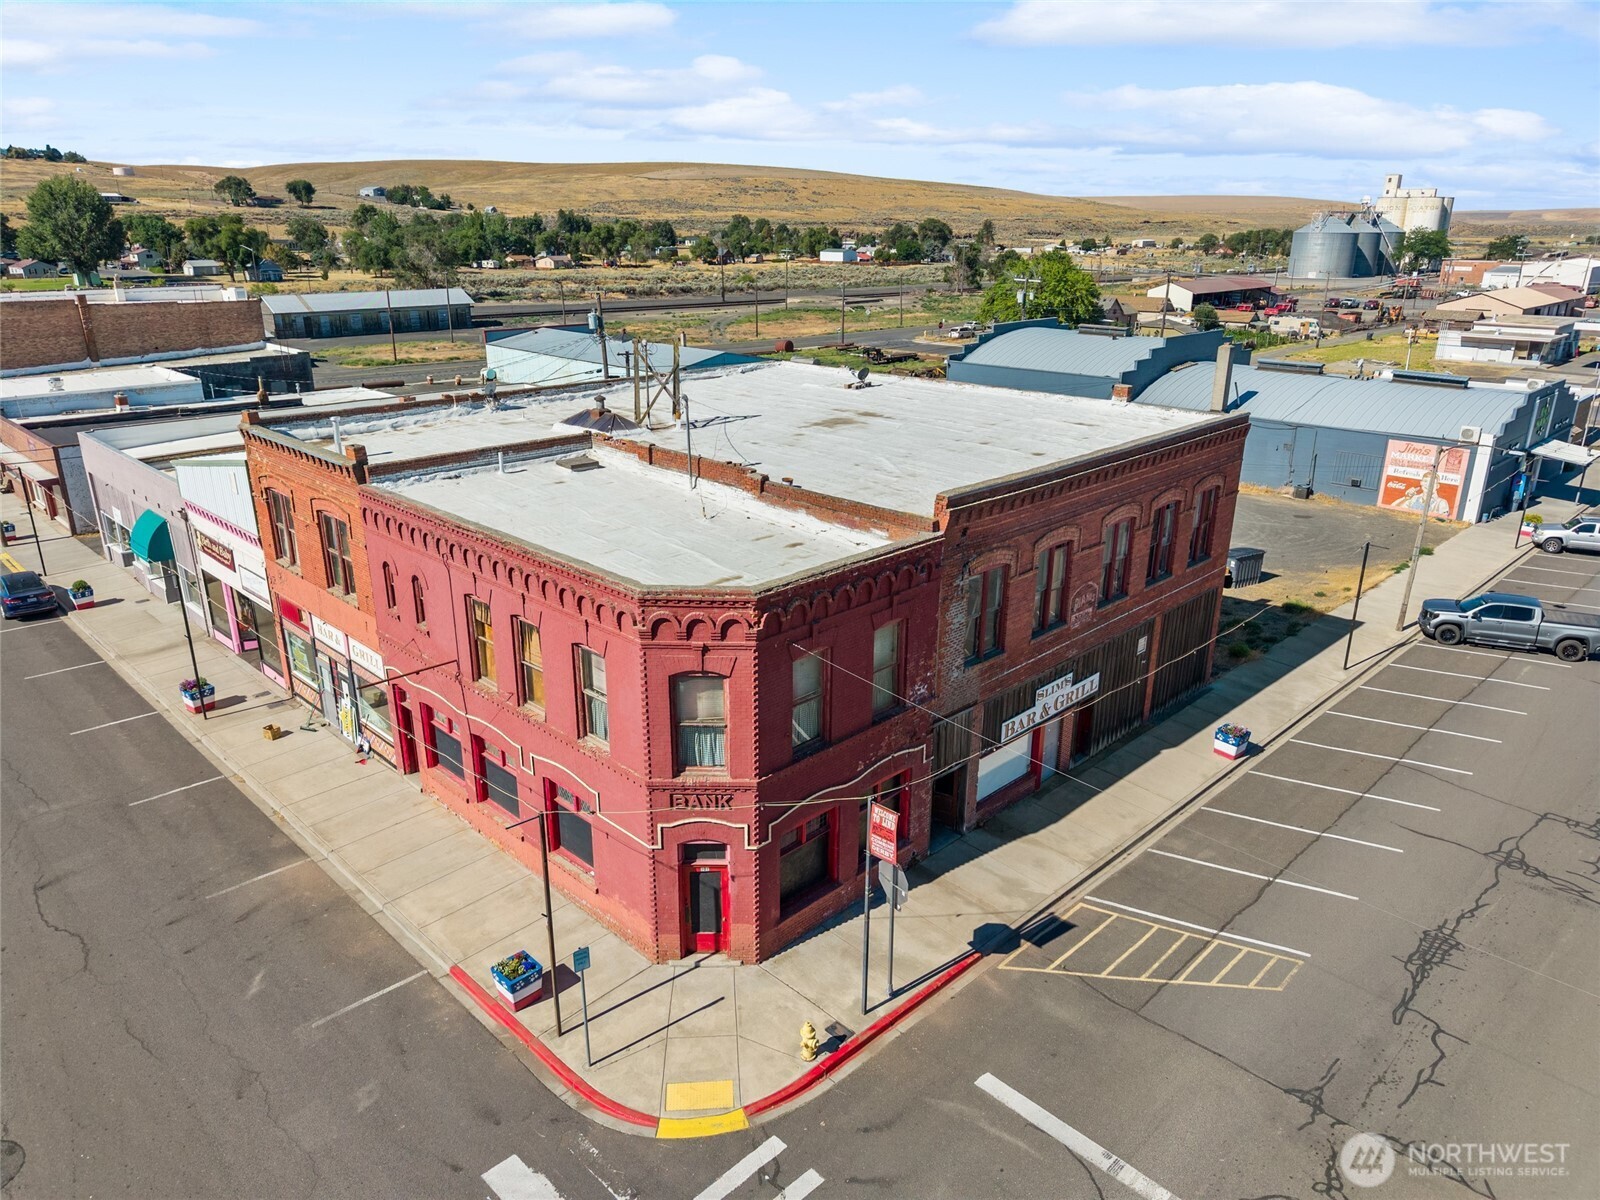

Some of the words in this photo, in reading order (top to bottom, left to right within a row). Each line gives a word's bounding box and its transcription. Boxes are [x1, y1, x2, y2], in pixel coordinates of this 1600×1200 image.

[1399, 443, 1431, 455] Jim's
[1393, 468, 1421, 477] Refresh
[317, 624, 333, 642] BAR
[352, 645, 381, 671] GRILL
[1036, 676, 1072, 702] SLIM'S
[1003, 711, 1037, 740] BAR
[1039, 702, 1052, 720] &
[1053, 679, 1098, 711] GRILL
[670, 793, 734, 810] BANK
[873, 813, 881, 824] TO
